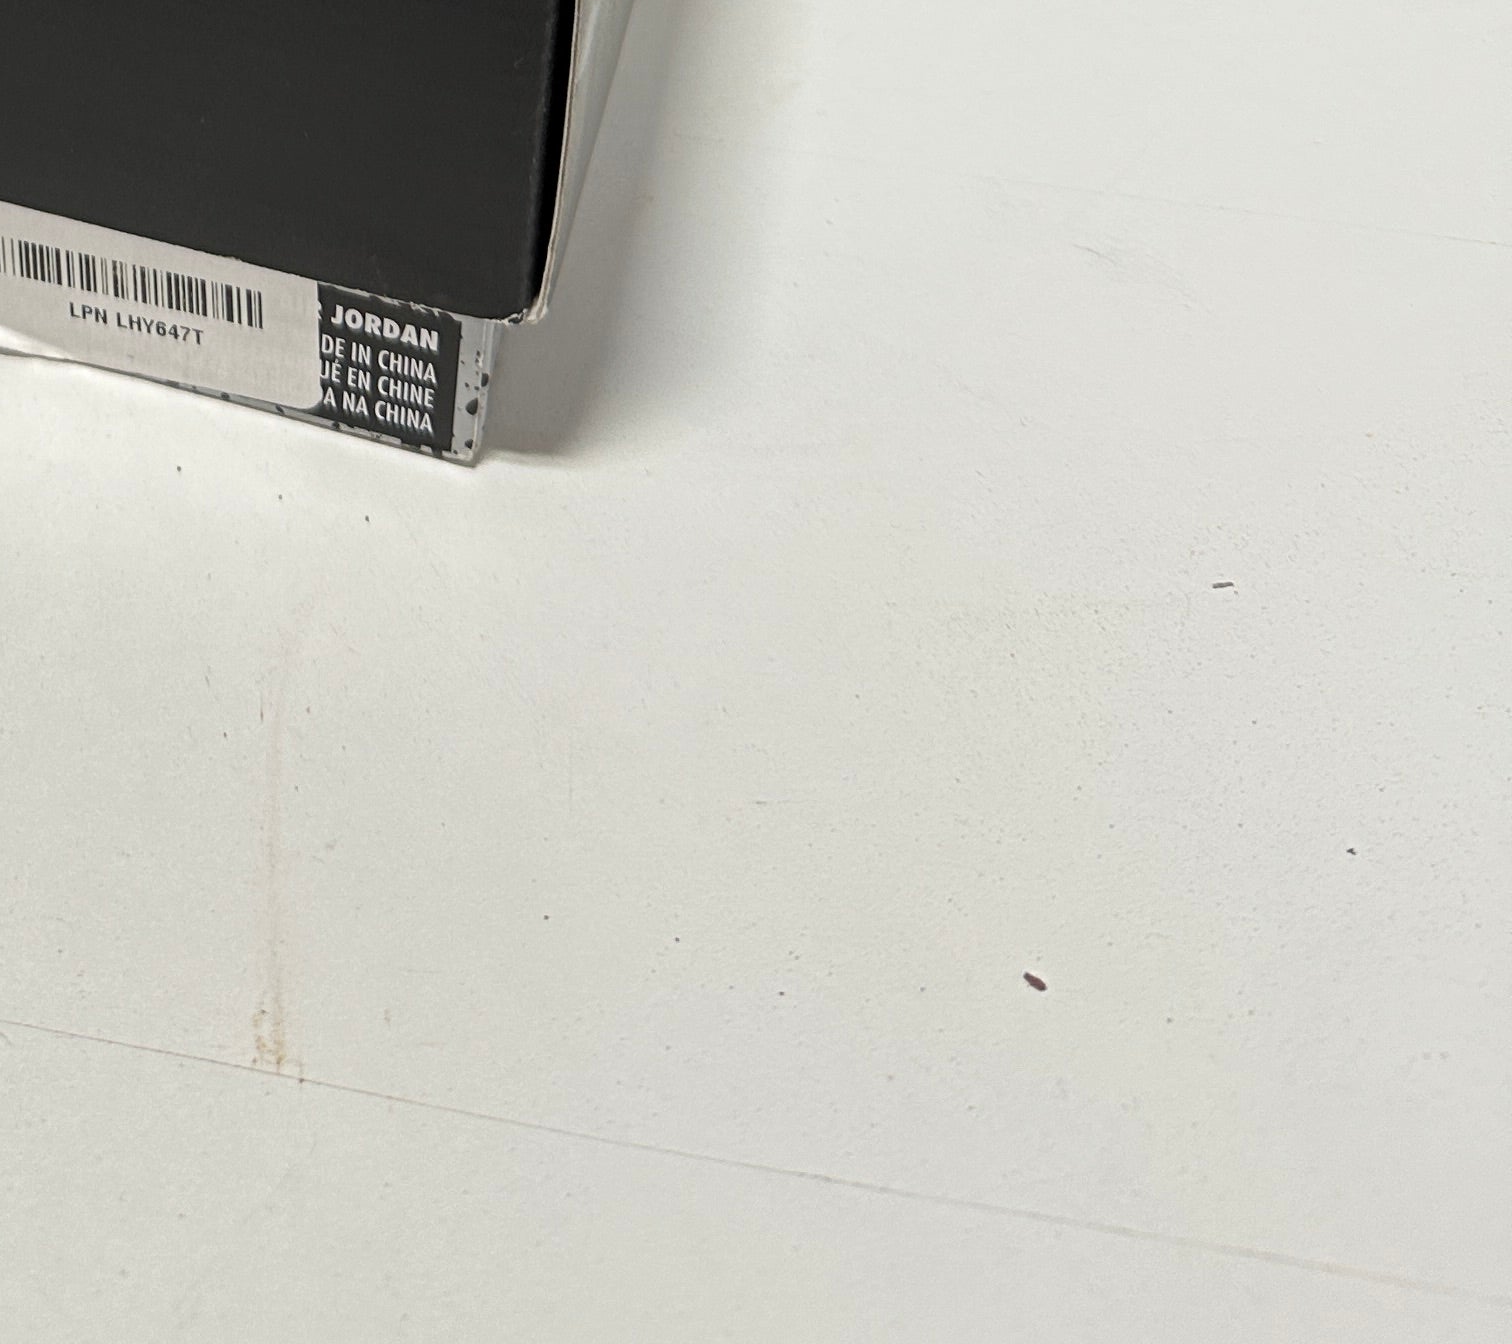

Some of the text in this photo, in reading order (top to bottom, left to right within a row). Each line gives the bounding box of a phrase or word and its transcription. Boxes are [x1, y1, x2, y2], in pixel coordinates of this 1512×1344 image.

[69, 302, 204, 345] LPN LHY647T
[331, 304, 439, 352] JORDAN
[351, 342, 372, 366] IN
[378, 350, 437, 385] CHINA
[347, 367, 371, 390] EN
[378, 376, 435, 408] CHINE
[342, 391, 369, 416] NA
[375, 401, 434, 433] CHINA
